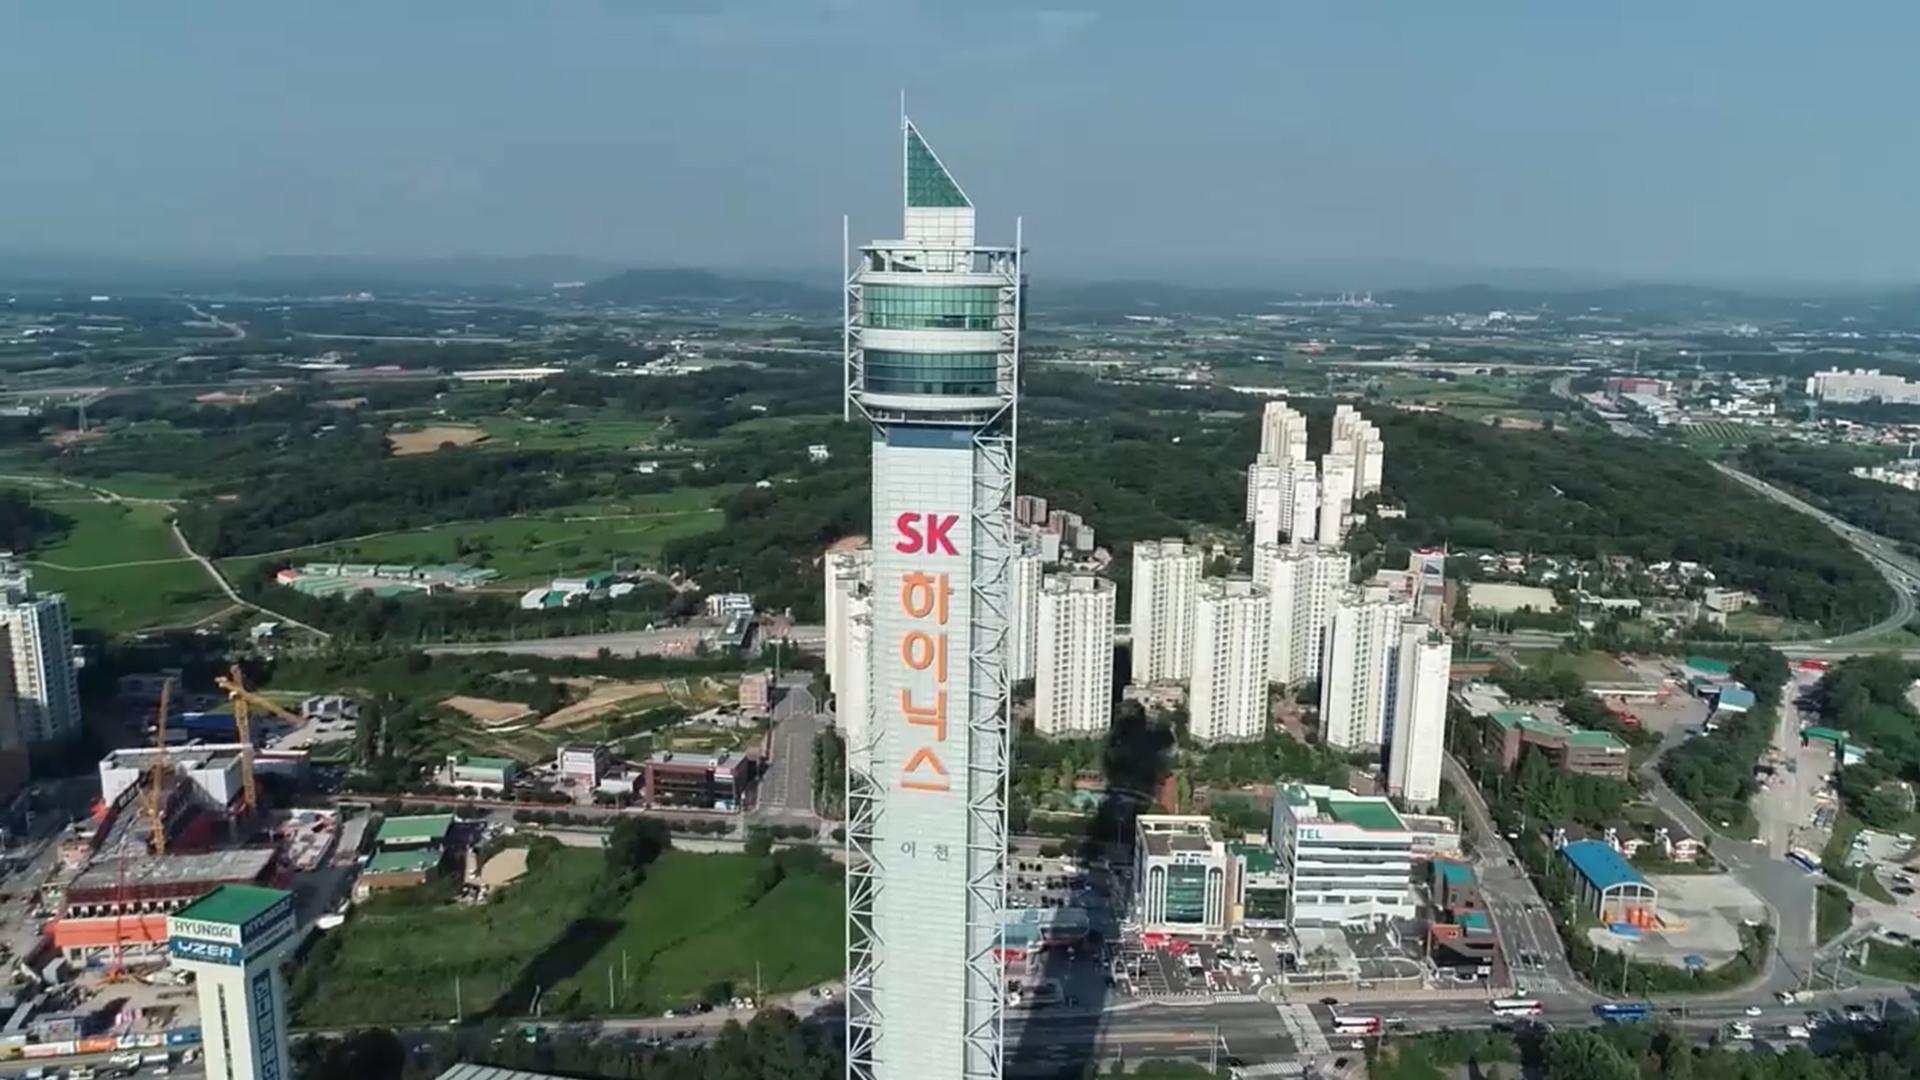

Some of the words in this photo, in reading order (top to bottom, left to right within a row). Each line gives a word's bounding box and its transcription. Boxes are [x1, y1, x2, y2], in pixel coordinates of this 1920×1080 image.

[895, 512, 960, 556] SK
[901, 571, 954, 792] 하이닉스
[1300, 829, 1323, 839] TEL
[174, 919, 233, 938] HYUNDAI
